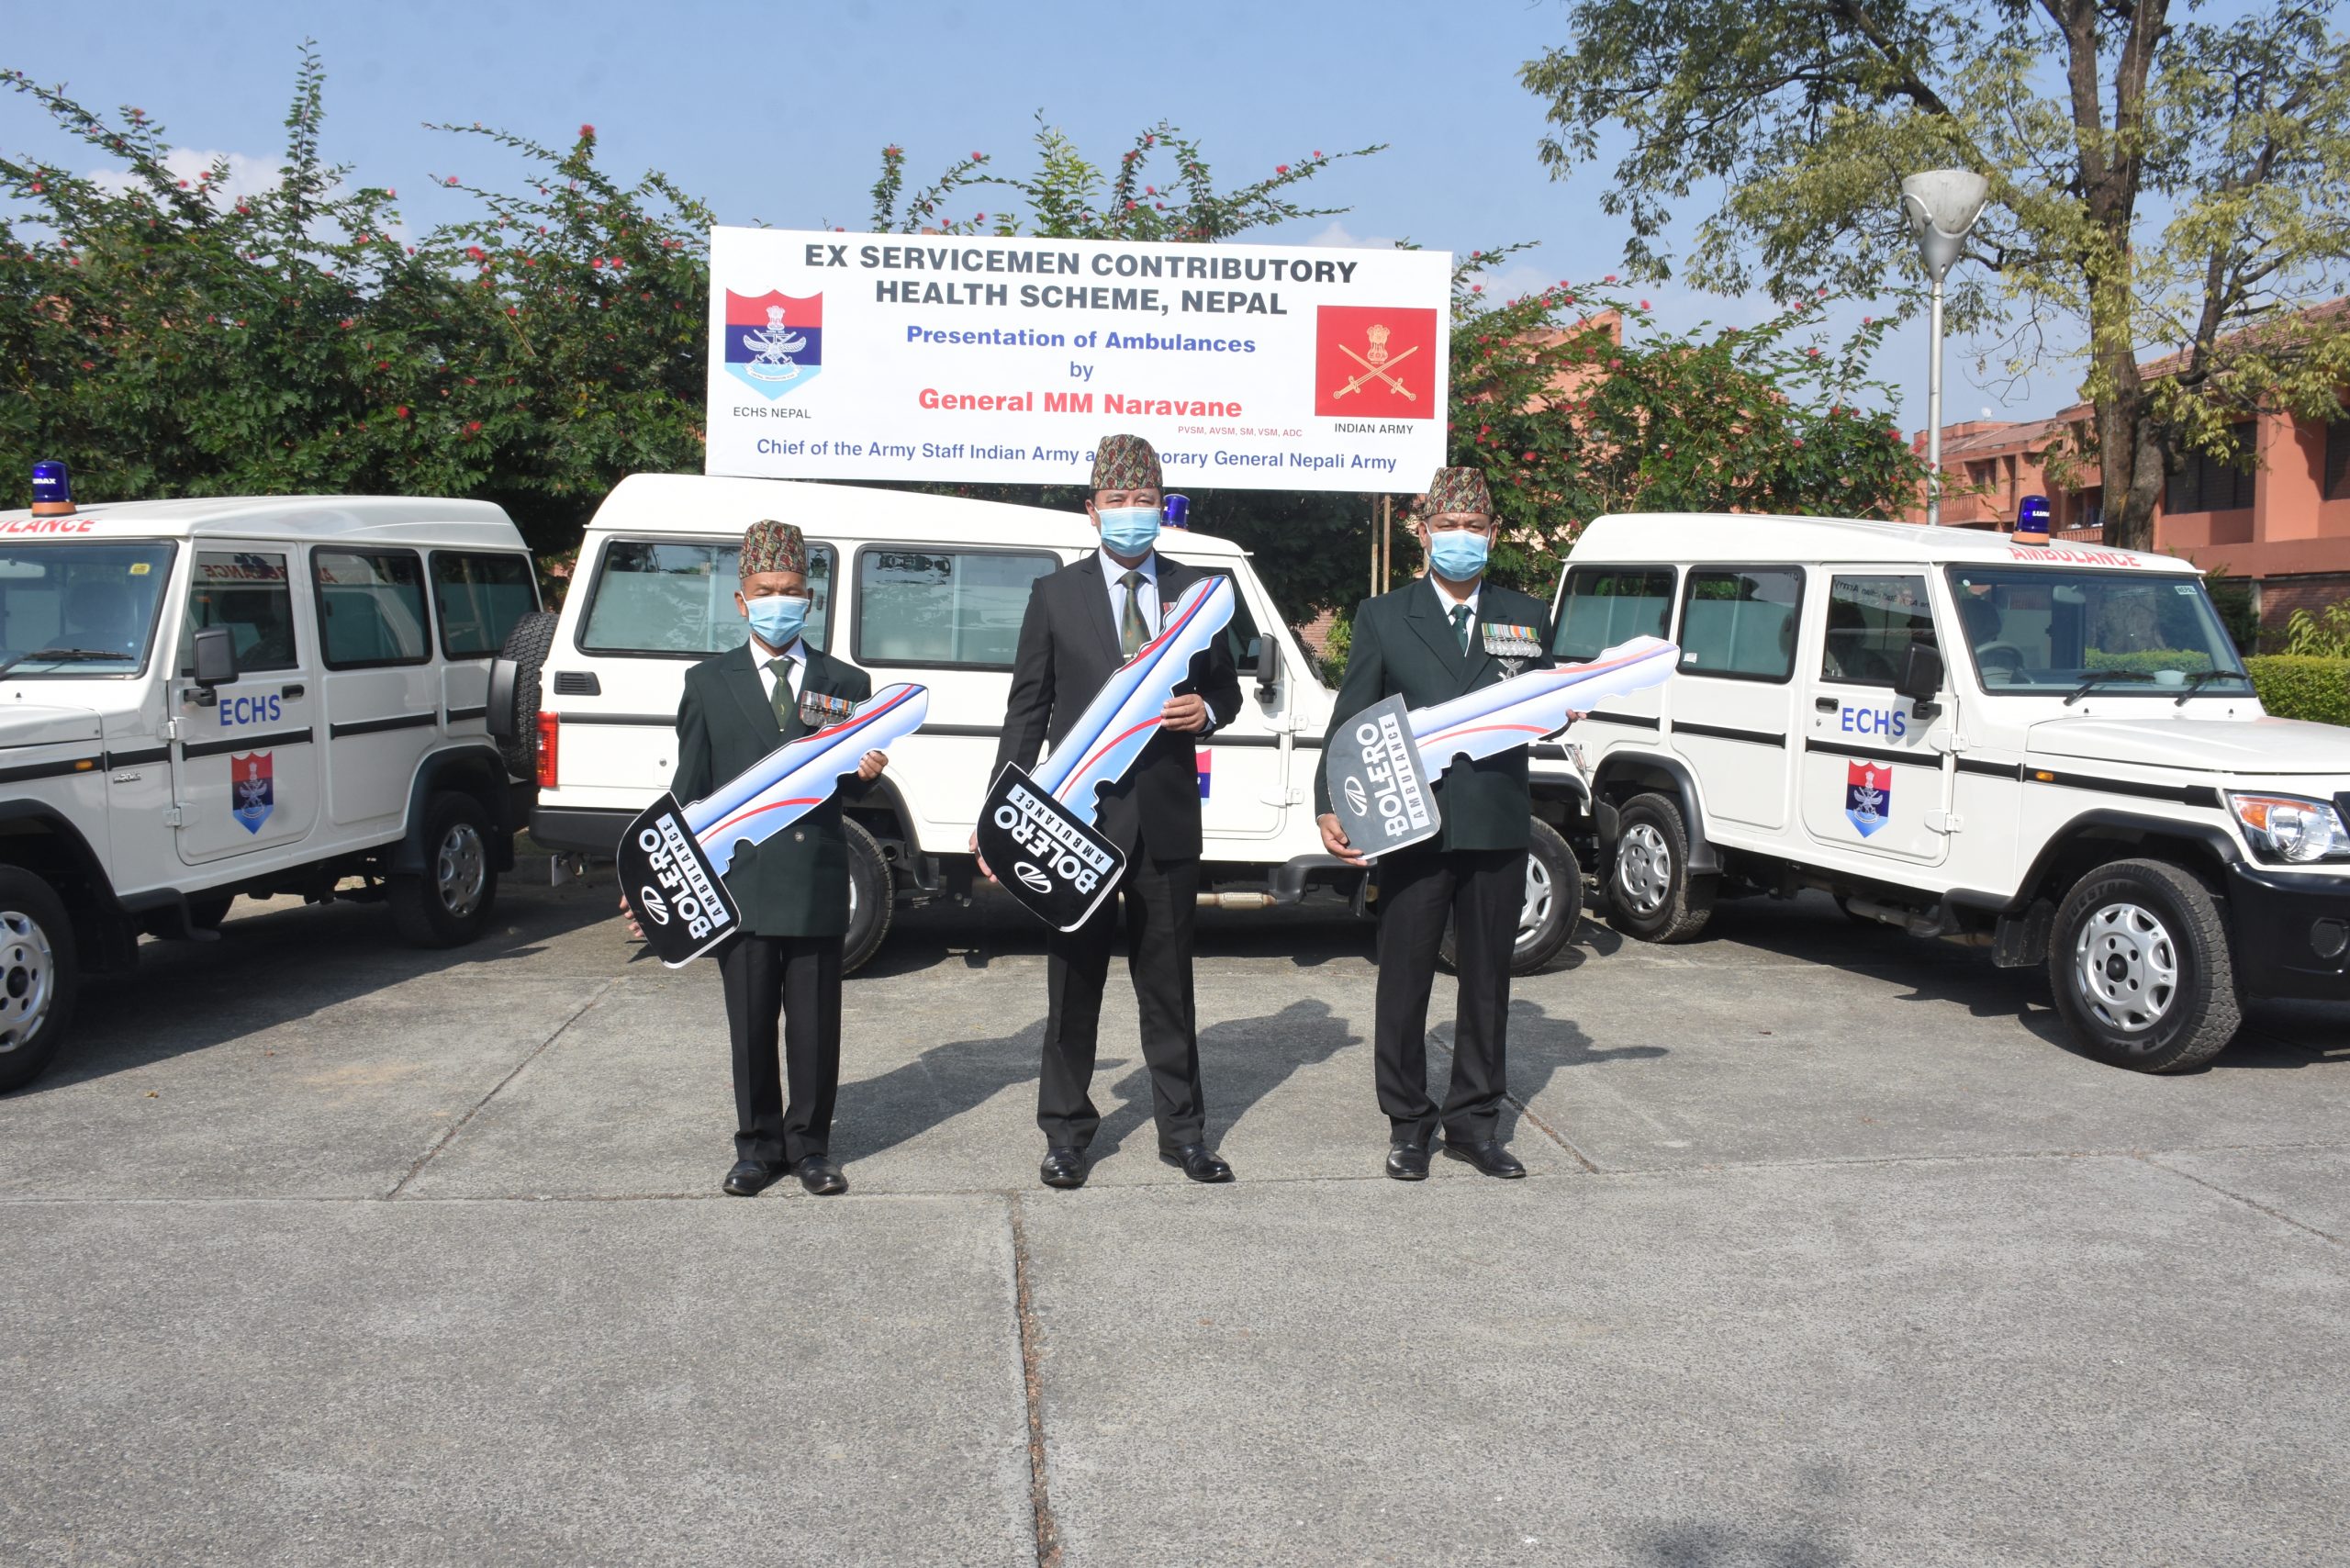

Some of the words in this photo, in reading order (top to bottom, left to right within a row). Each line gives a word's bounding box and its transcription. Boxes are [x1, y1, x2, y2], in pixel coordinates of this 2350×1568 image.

[806, 244, 847, 267] EX
[860, 246, 1079, 274] SERVICEMEN
[1091, 253, 1358, 283] CONTRIBUTORY
[877, 280, 1007, 306] HEALTH
[1021, 285, 1168, 316] SCHEME,
[1182, 290, 1287, 315] NEPAL
[908, 326, 1064, 346] Presentation
[1074, 331, 1097, 347] of
[1105, 332, 1255, 353] Ambulances
[1070, 361, 1093, 382] by
[733, 407, 767, 418] ECHS
[772, 408, 811, 419] NEPAL
[919, 388, 1032, 411] General
[1045, 392, 1092, 412] MM
[1104, 394, 1242, 417] Naravane
[1179, 426, 1207, 435] PVSM,
[1209, 427, 1238, 436] AVSM,
[1240, 428, 1257, 436] SM,
[1259, 428, 1281, 437] VSM,
[1282, 429, 1303, 437] ADC
[1335, 422, 1375, 433] INDIAN
[1379, 424, 1414, 434] ARMY
[757, 439, 804, 454] Chief
[811, 441, 828, 454] of
[834, 442, 862, 455] the
[868, 442, 915, 461] Army
[923, 443, 964, 458] Staff
[971, 444, 1024, 460] Indian
[1033, 446, 1079, 465] Army
[1155, 452, 1208, 469] orary
[1214, 451, 1282, 466] General
[1291, 453, 1344, 471] Nepali
[1351, 454, 1396, 473] Army
[2008, 547, 2142, 567] AMBULANCE
[219, 694, 281, 726] ECHS
[1841, 707, 1906, 736] ECHS
[1356, 723, 1409, 836] BOLERO
[1384, 722, 1424, 819] AMBULANCE
[1016, 791, 1104, 864] AMBULANCE
[994, 805, 1099, 894] BOLERO
[639, 828, 712, 939] BOLERO
[663, 823, 722, 916] AMBULANCE
